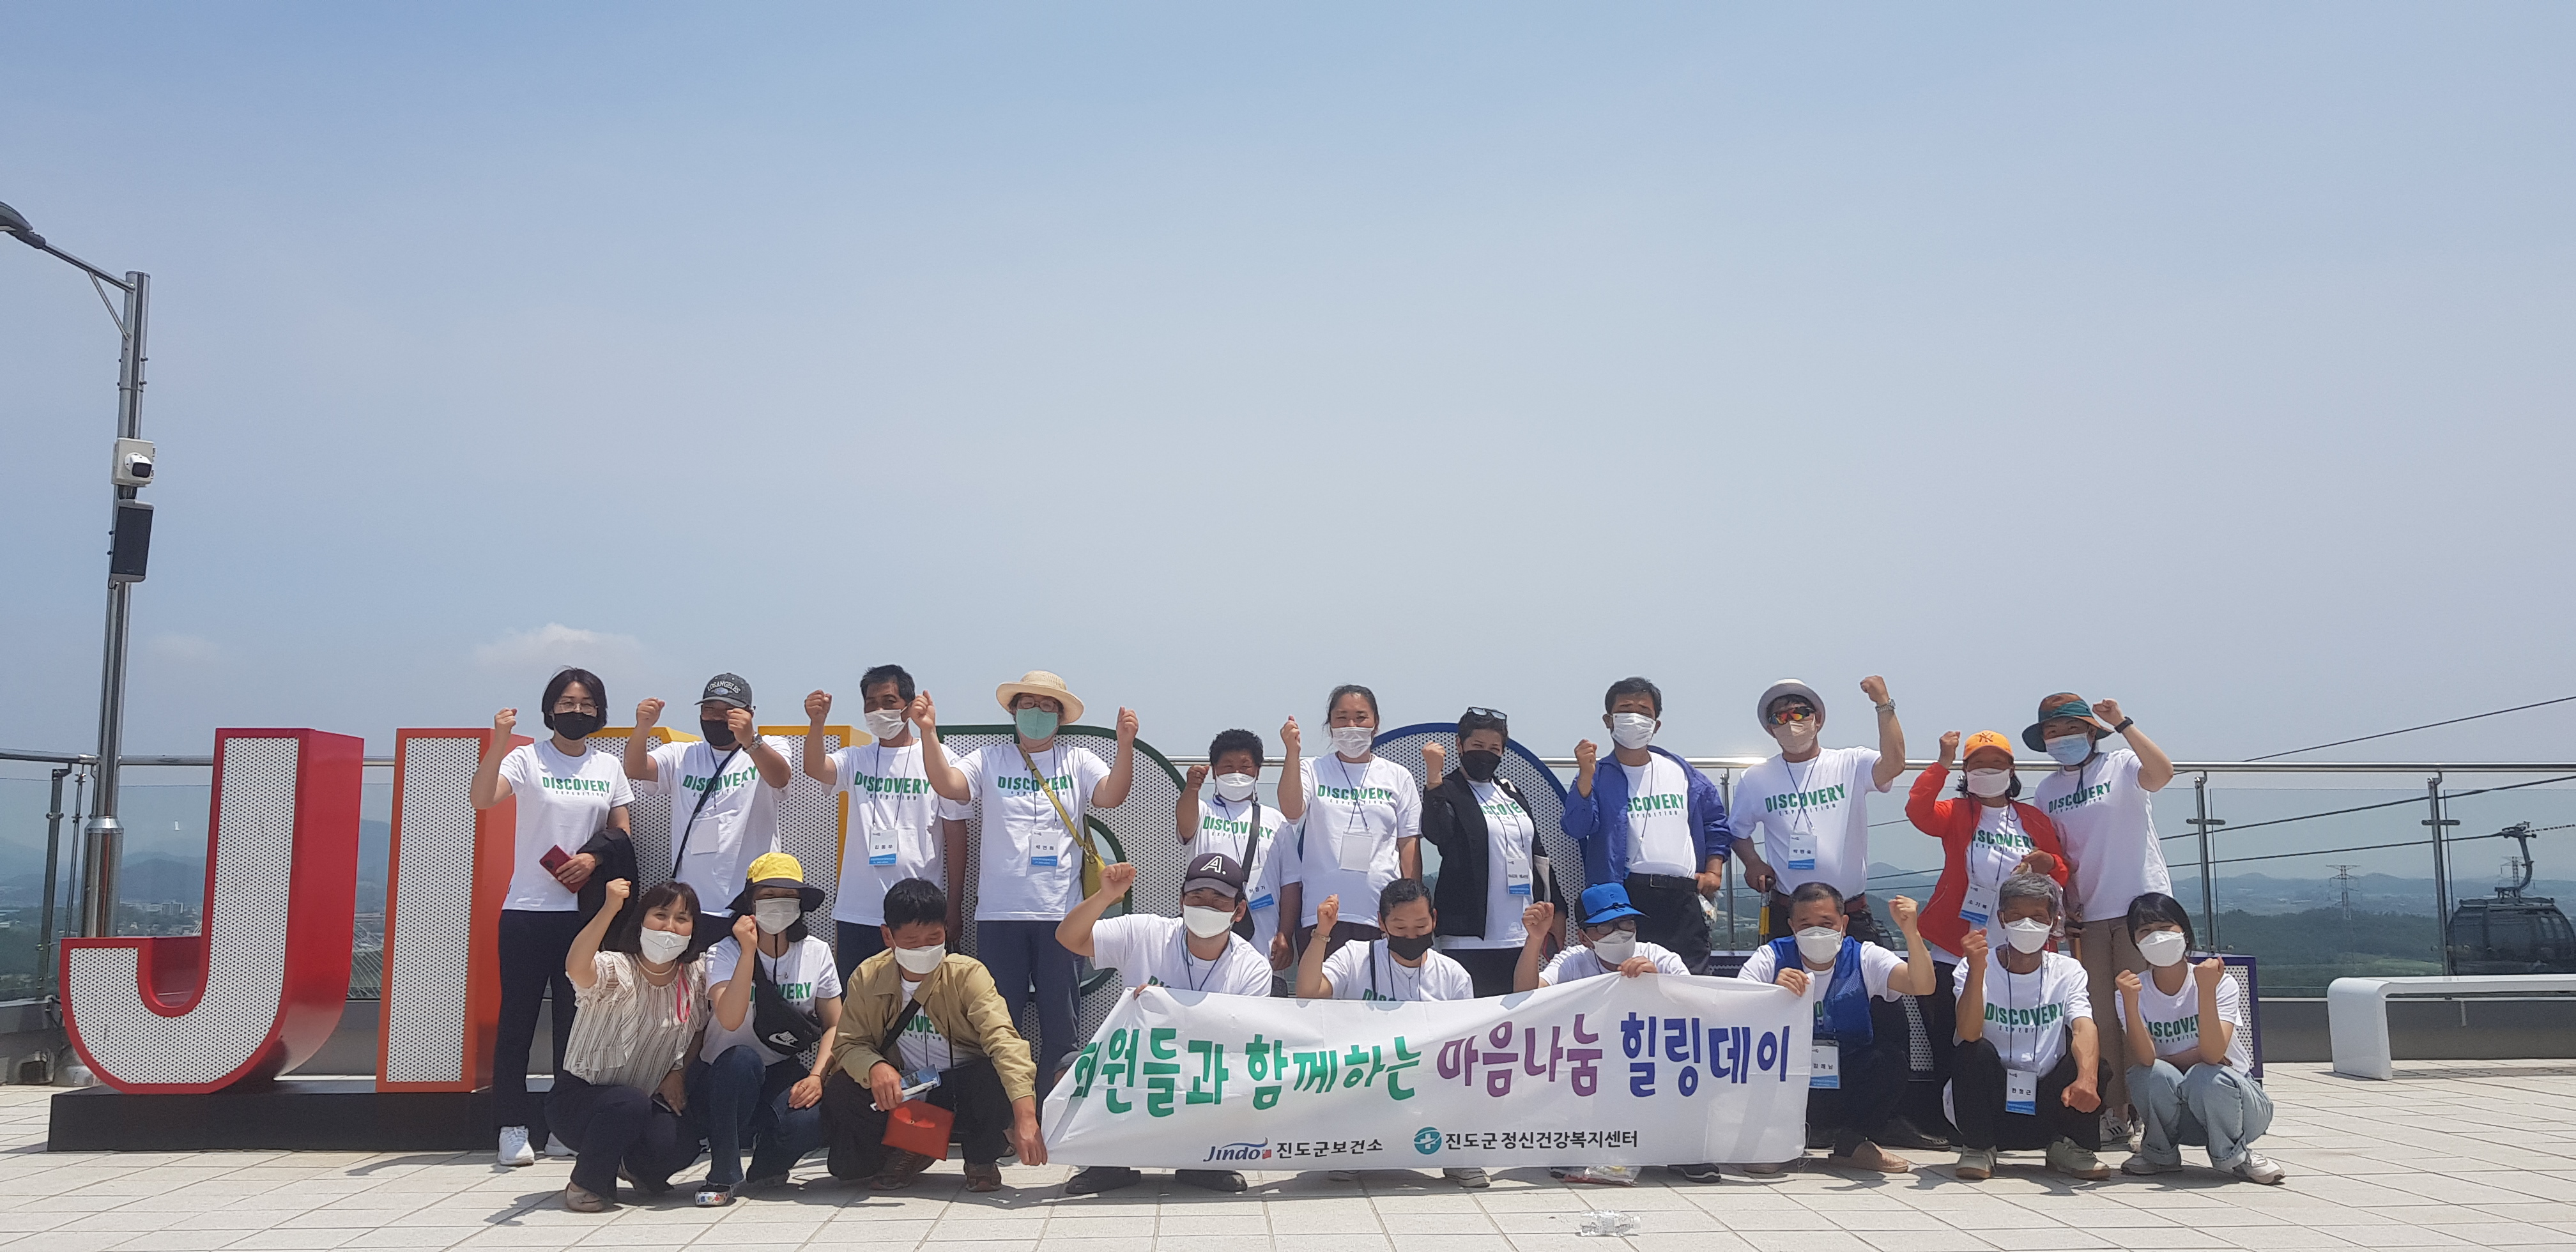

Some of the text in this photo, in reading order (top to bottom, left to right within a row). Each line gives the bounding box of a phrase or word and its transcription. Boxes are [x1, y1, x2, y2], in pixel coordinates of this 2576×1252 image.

[542, 776, 611, 793] DISCOVERY
[854, 770, 931, 795] DISCOVERY
[1317, 784, 1393, 802] DISCOVERY
[1627, 793, 1684, 812] SCOVERY
[1765, 782, 1845, 813] DISCOVERY
[2048, 781, 2112, 814] DISCOVERY
[1202, 816, 1273, 840] DISCOVRY
[1972, 829, 2036, 851] ISCOVER
[1984, 999, 2064, 1026] DISCOVERY
[2147, 1014, 2199, 1037] ISCOVE
[1245, 1034, 1422, 1110] 함께하는
[1437, 1014, 1603, 1097] 마음나눔
[1621, 1012, 1790, 1097] 힐링데이
[1276, 1139, 1384, 1159] 진도군보건소
[1445, 1130, 1638, 1150] 진도군 정신건강복지센터
[1203, 1145, 1261, 1162] Jindo
